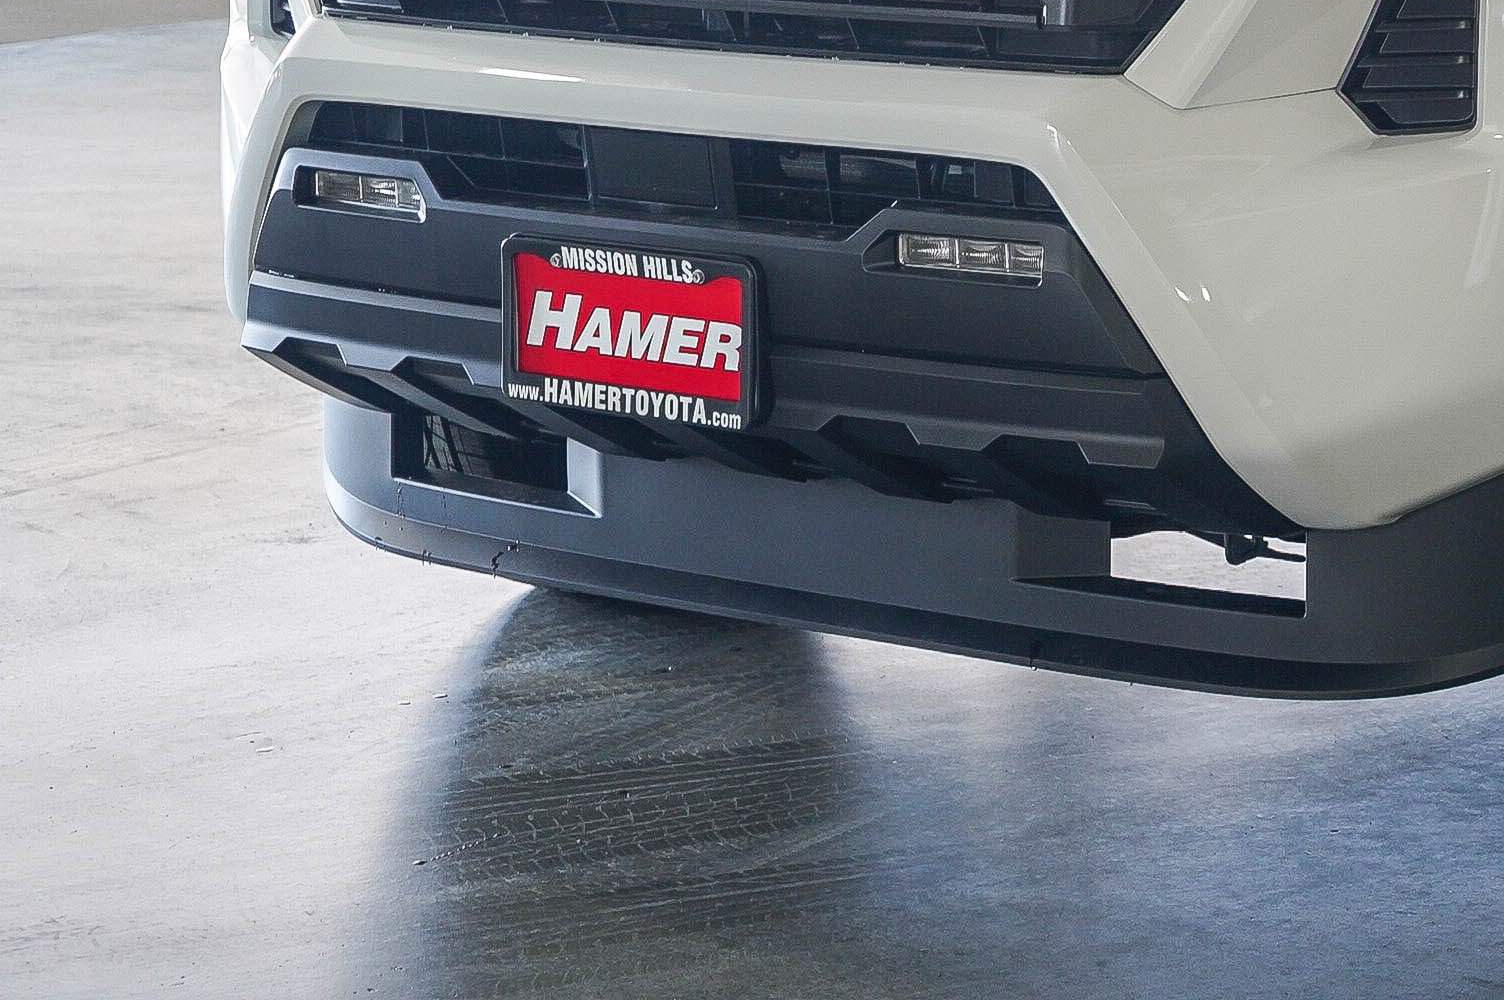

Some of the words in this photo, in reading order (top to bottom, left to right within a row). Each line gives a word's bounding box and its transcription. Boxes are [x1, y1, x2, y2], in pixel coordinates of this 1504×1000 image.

[560, 246, 637, 276] MISSION
[643, 255, 694, 284] HILLS
[526, 290, 742, 372] HAMER
[508, 377, 741, 430] www.HAMERTOYOTA.com
